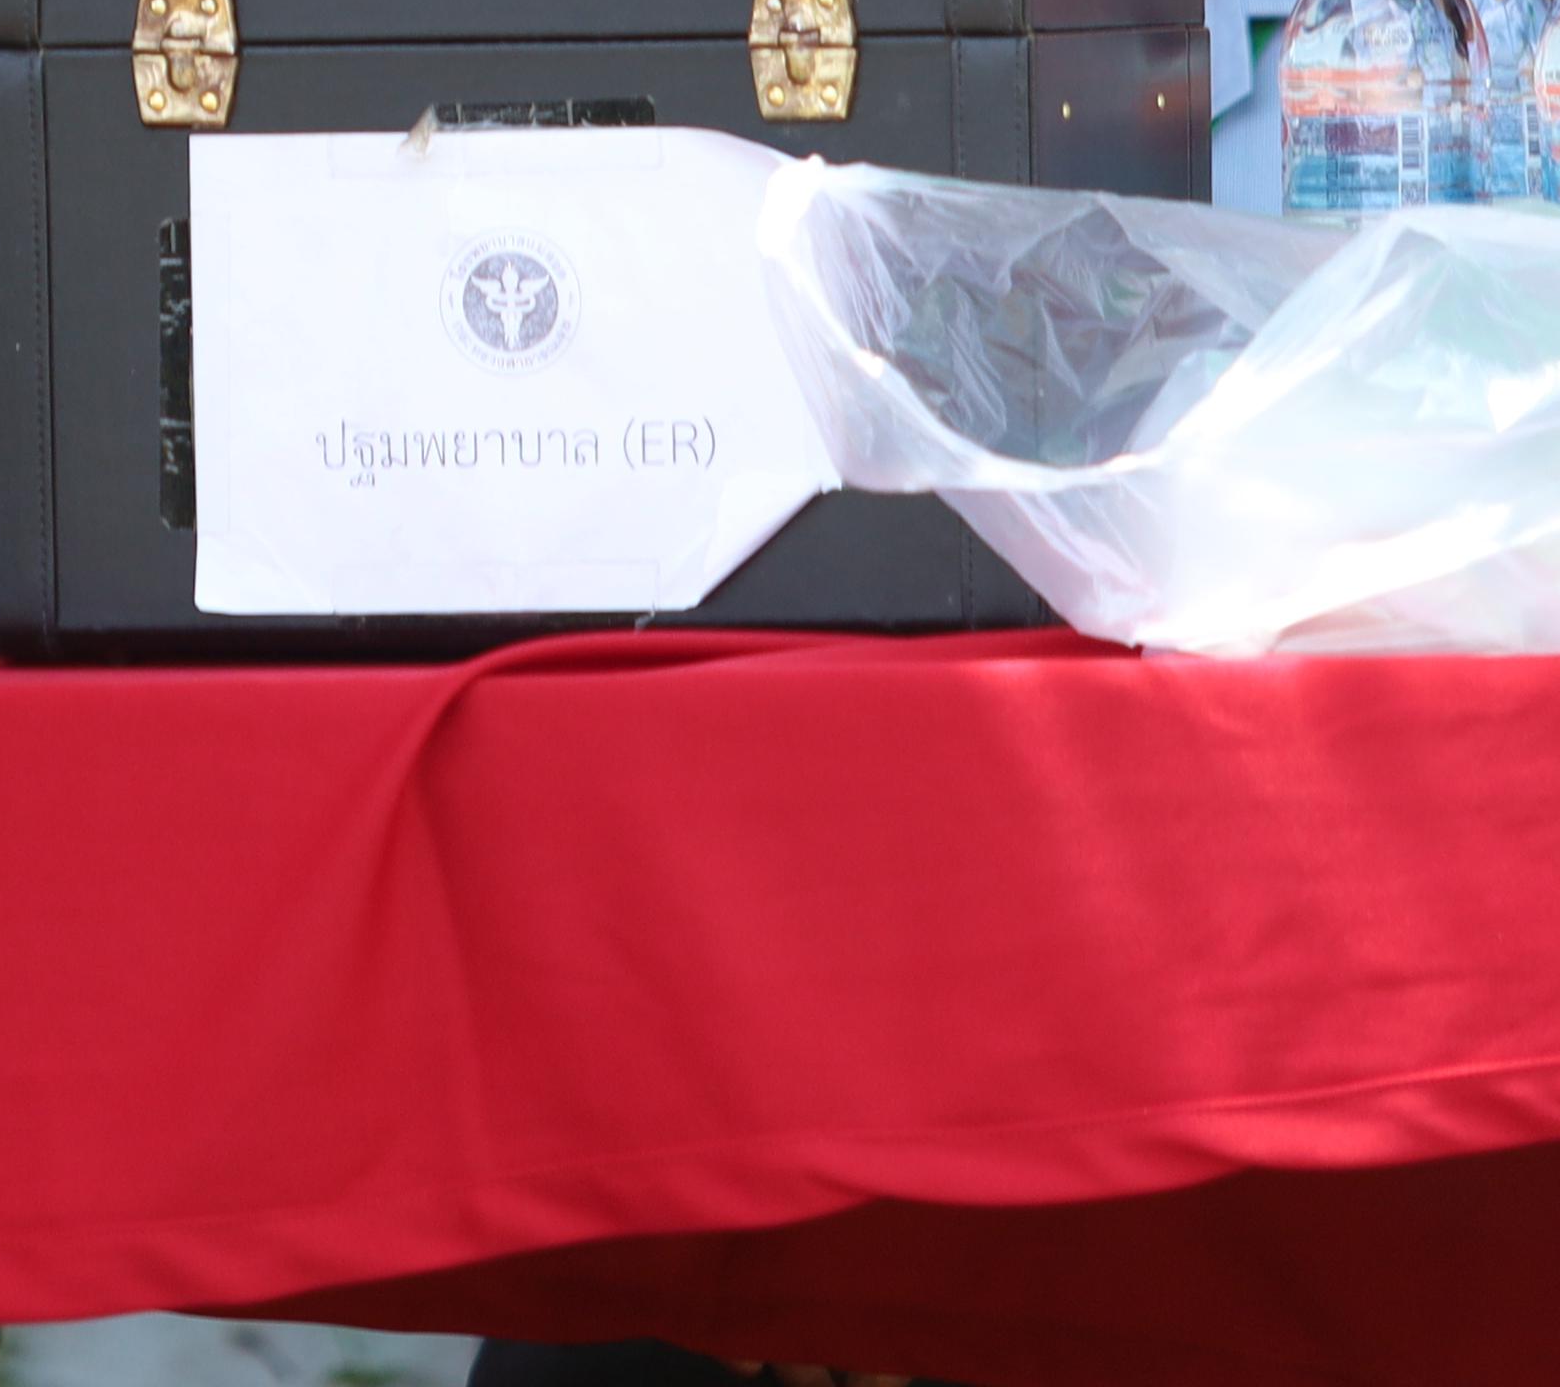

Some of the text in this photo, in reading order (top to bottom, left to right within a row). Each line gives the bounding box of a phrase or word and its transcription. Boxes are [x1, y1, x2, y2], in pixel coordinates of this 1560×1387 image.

[315, 415, 716, 488] ปฐมพยาบาล (ER)
